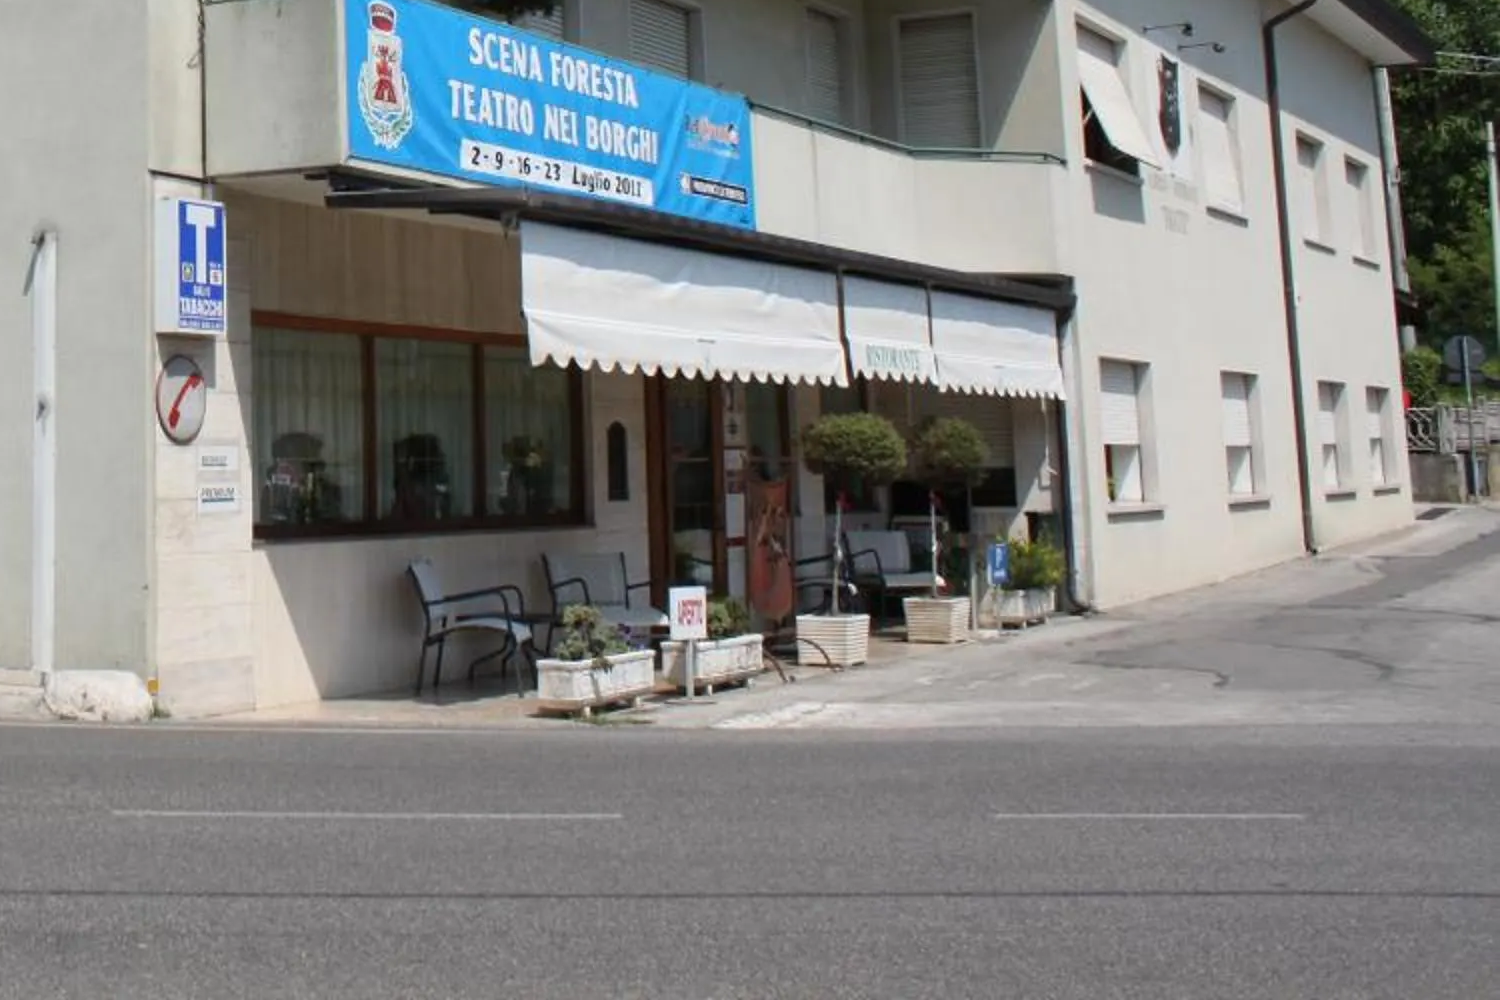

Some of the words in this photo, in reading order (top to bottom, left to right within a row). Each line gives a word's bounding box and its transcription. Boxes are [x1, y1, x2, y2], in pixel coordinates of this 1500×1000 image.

[468, 27, 544, 83] SCENA
[549, 51, 639, 108] FORESTA
[448, 80, 533, 136] TEATRO
[544, 103, 579, 147] NEI
[585, 115, 660, 165] BORGHI
[472, 146, 480, 165] 2
[495, 152, 503, 169] 9
[518, 157, 531, 175] 16
[544, 162, 561, 181] 23
[572, 166, 610, 192] Luglio
[615, 176, 642, 198] 2011
[186, 204, 215, 284] T
